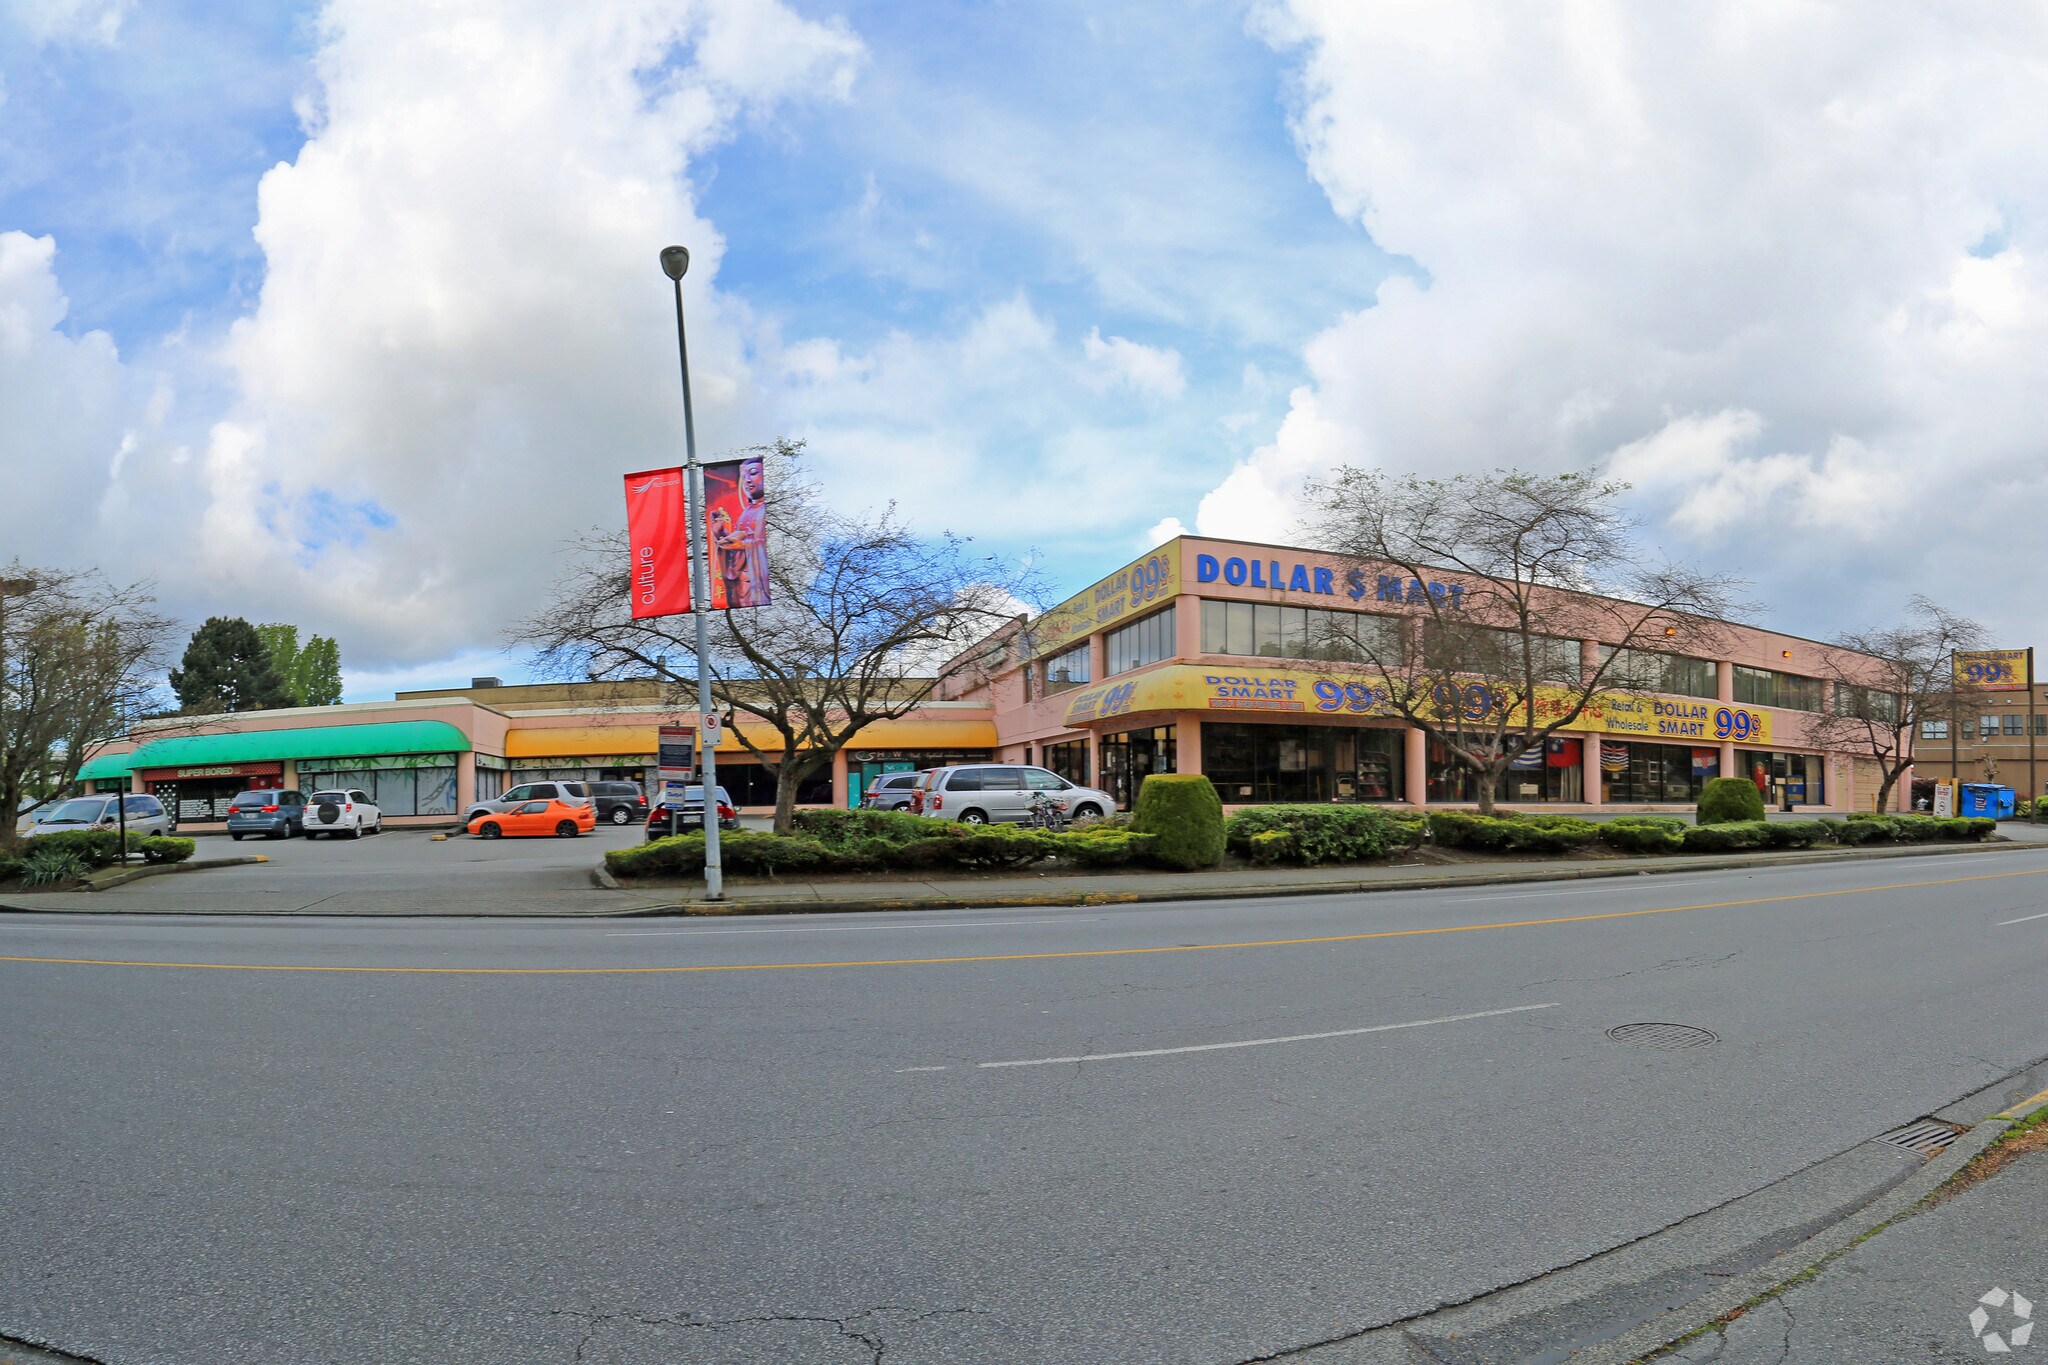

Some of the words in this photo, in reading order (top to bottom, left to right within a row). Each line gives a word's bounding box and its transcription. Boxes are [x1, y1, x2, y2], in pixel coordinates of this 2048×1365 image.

[637, 546, 655, 605] culture
[1197, 553, 1334, 596] DOLLAR
[1094, 571, 1128, 604] DOLLAR
[1096, 596, 1126, 624] SMART
[1205, 675, 1297, 688] DOLLAR
[1217, 687, 1295, 699] SMART
[1611, 699, 1635, 712] Retail
[1636, 701, 1643, 713] &
[1654, 702, 1708, 720] DOLLAR
[1606, 716, 1649, 732] Wholesale
[1658, 720, 1705, 736] SMART
[1714, 707, 1761, 740] 99¢
[177, 768, 204, 777] SUPER
[205, 767, 233, 776] BORED
